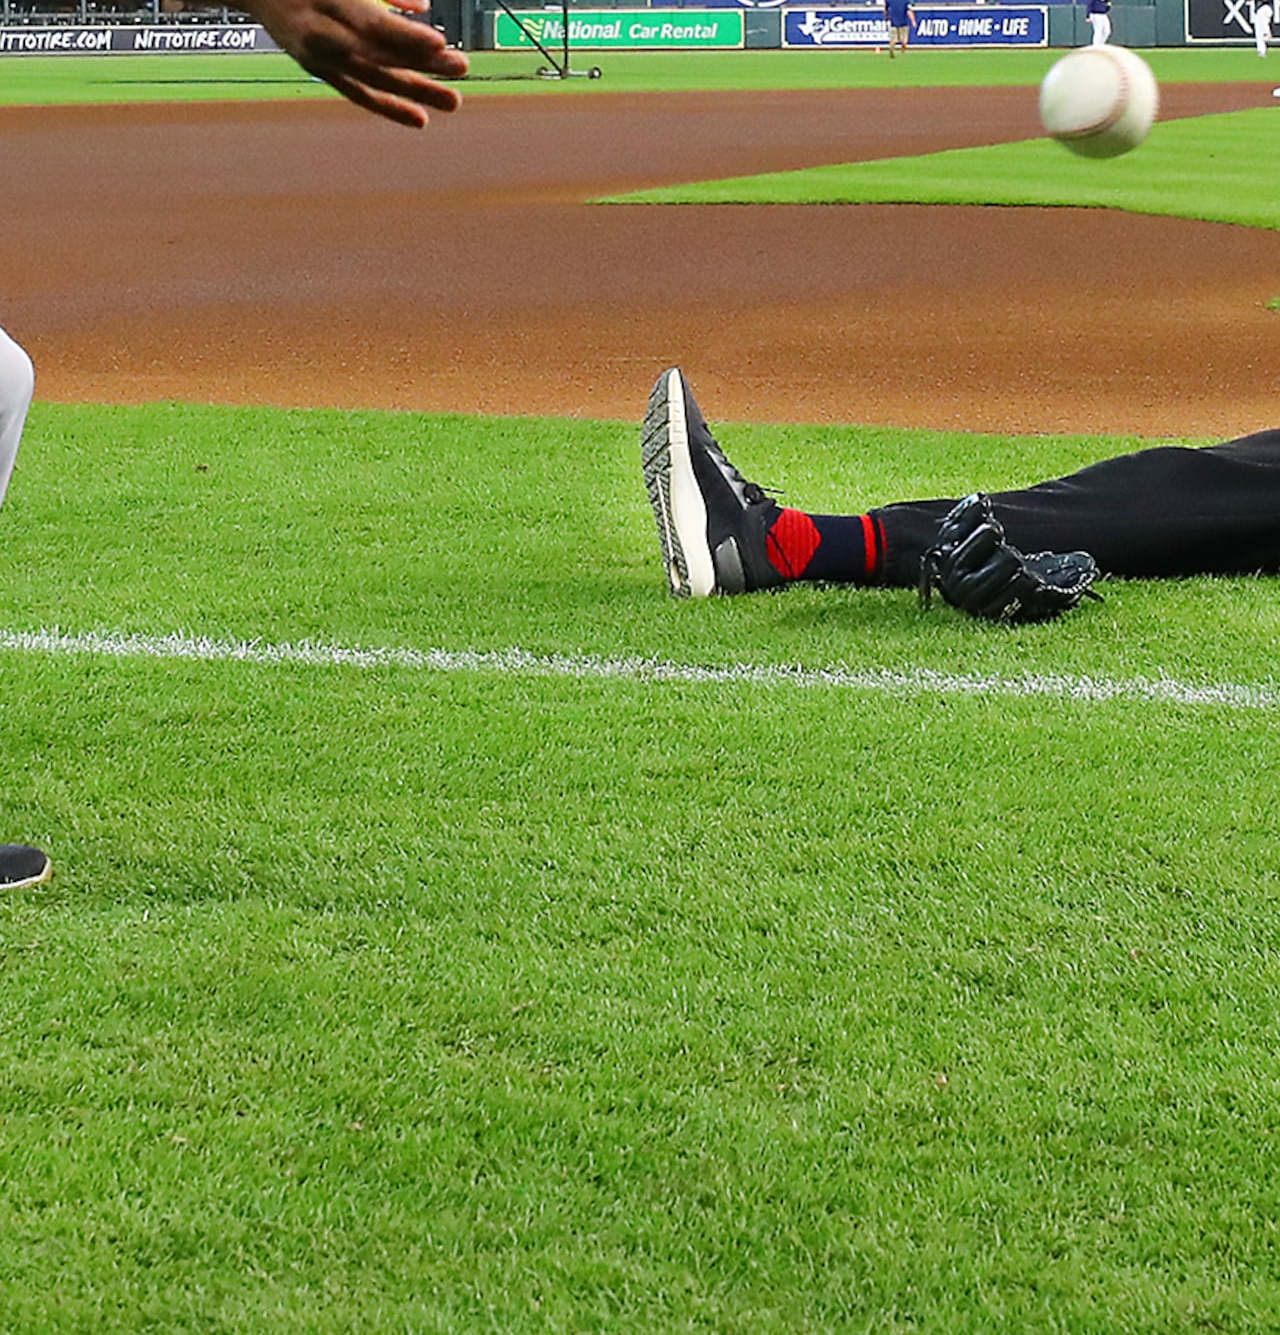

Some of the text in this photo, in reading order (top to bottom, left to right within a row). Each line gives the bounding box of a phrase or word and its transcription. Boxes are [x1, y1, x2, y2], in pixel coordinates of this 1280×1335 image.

[543, 20, 718, 40] National Car Rental
[829, 16, 891, 32] German
[917, 18, 1029, 37] AUTO HOME LIFE
[134, 29, 256, 50] NITTOTIRE.COM
